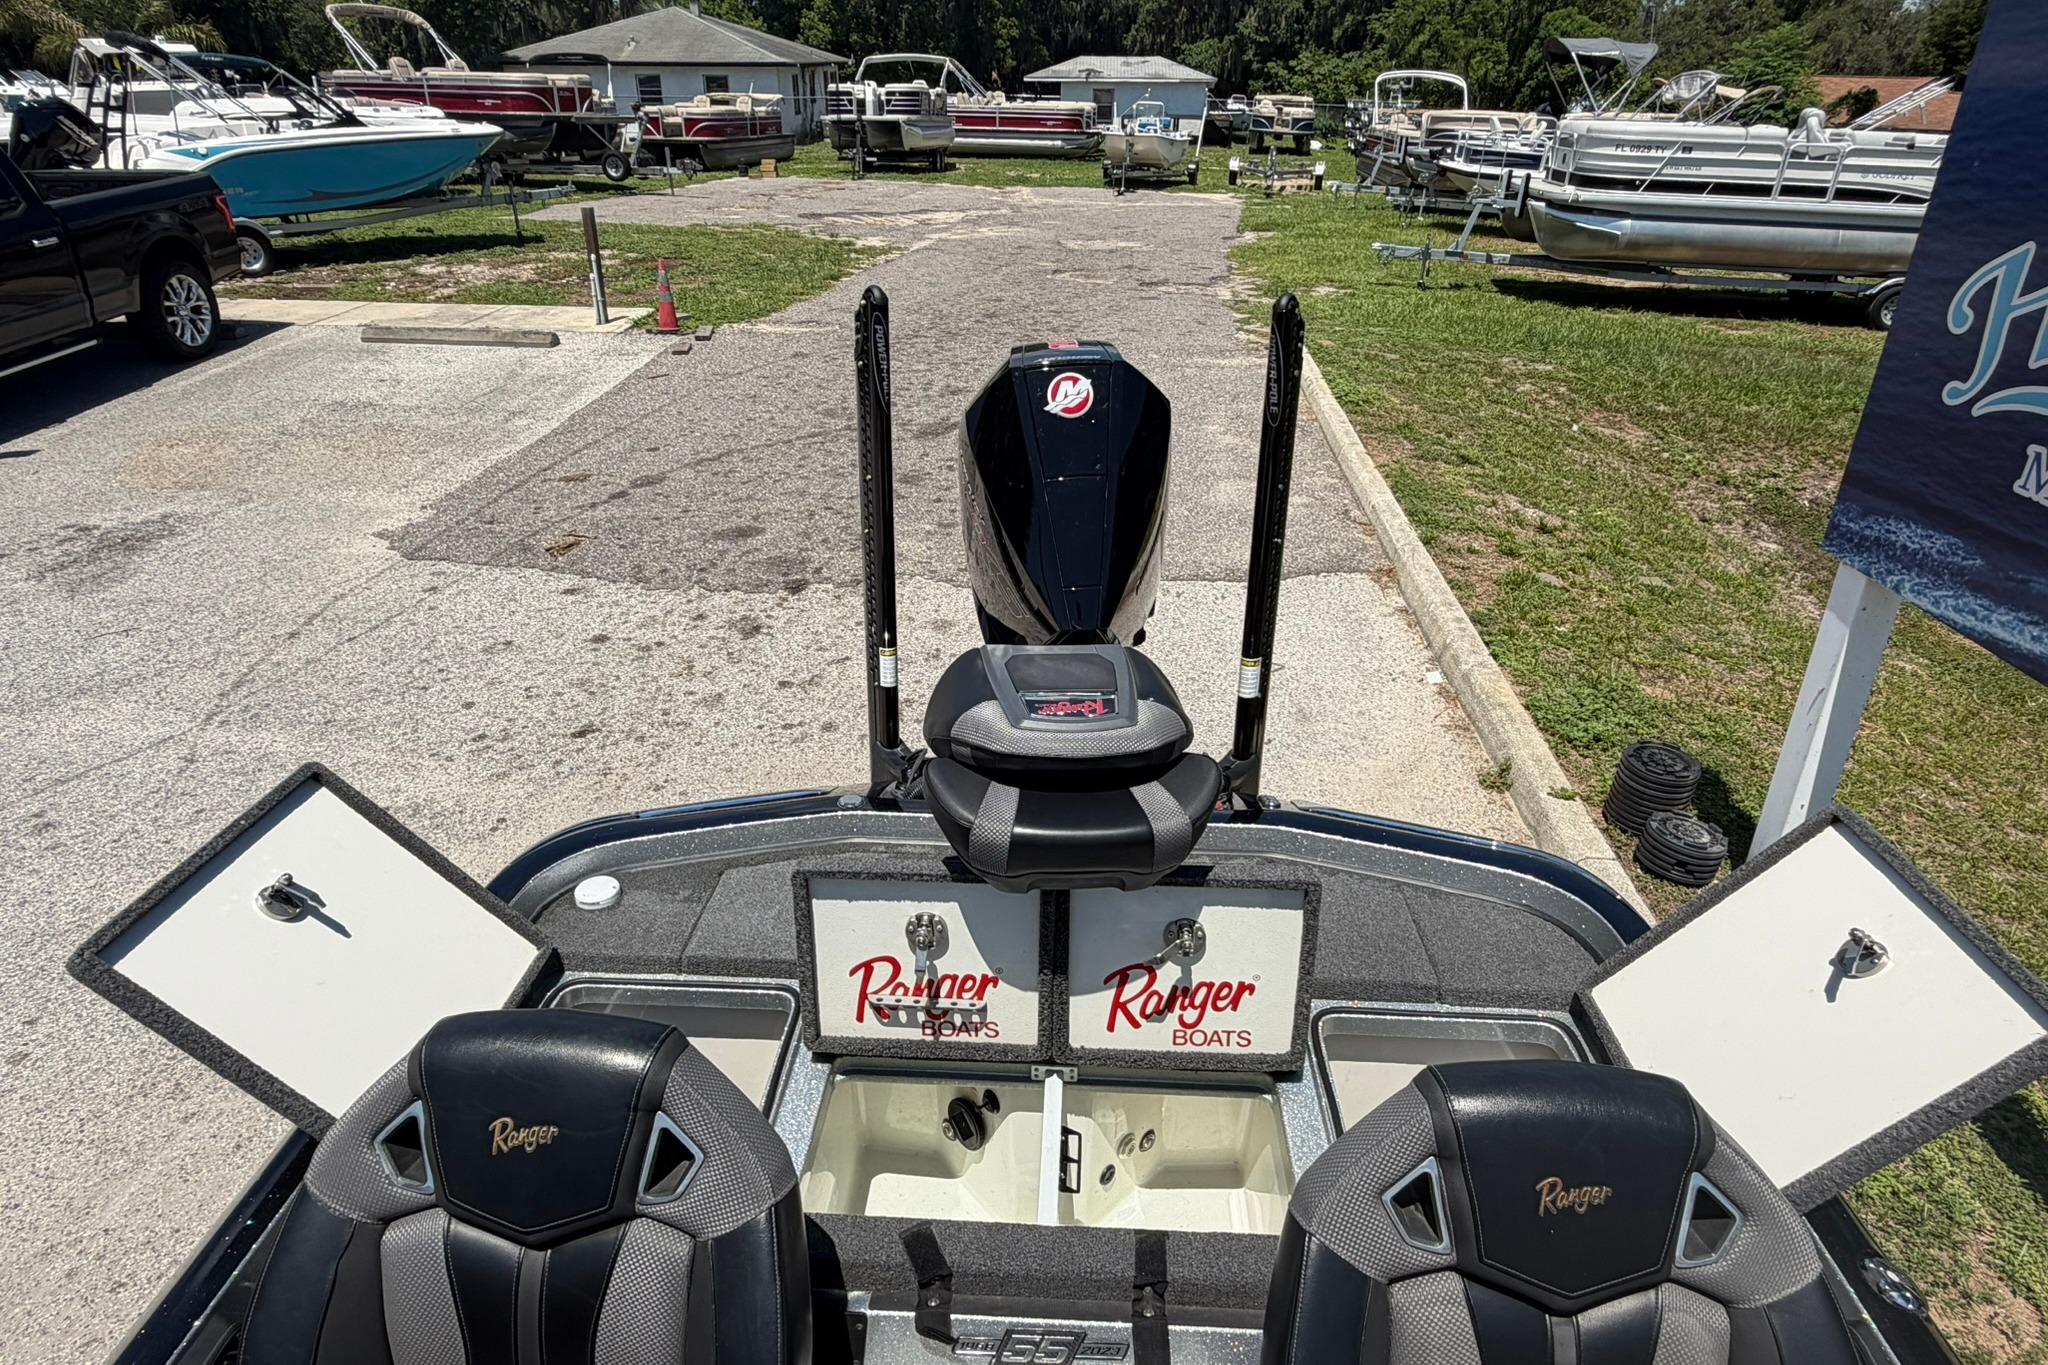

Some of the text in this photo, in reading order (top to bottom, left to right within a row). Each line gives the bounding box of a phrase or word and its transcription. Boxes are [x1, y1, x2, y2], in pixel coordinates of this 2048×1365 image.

[1614, 143, 1627, 152] FL
[1655, 145, 1668, 154] TY
[848, 955, 999, 1024] Ranger
[1103, 963, 1256, 1033] Ranger
[921, 1020, 1000, 1039] BOATS
[1172, 1029, 1252, 1048] BOATS
[488, 1116, 559, 1156] Ranger
[1535, 1176, 1613, 1217] Ranger
[1001, 1334, 1075, 1364] 55
